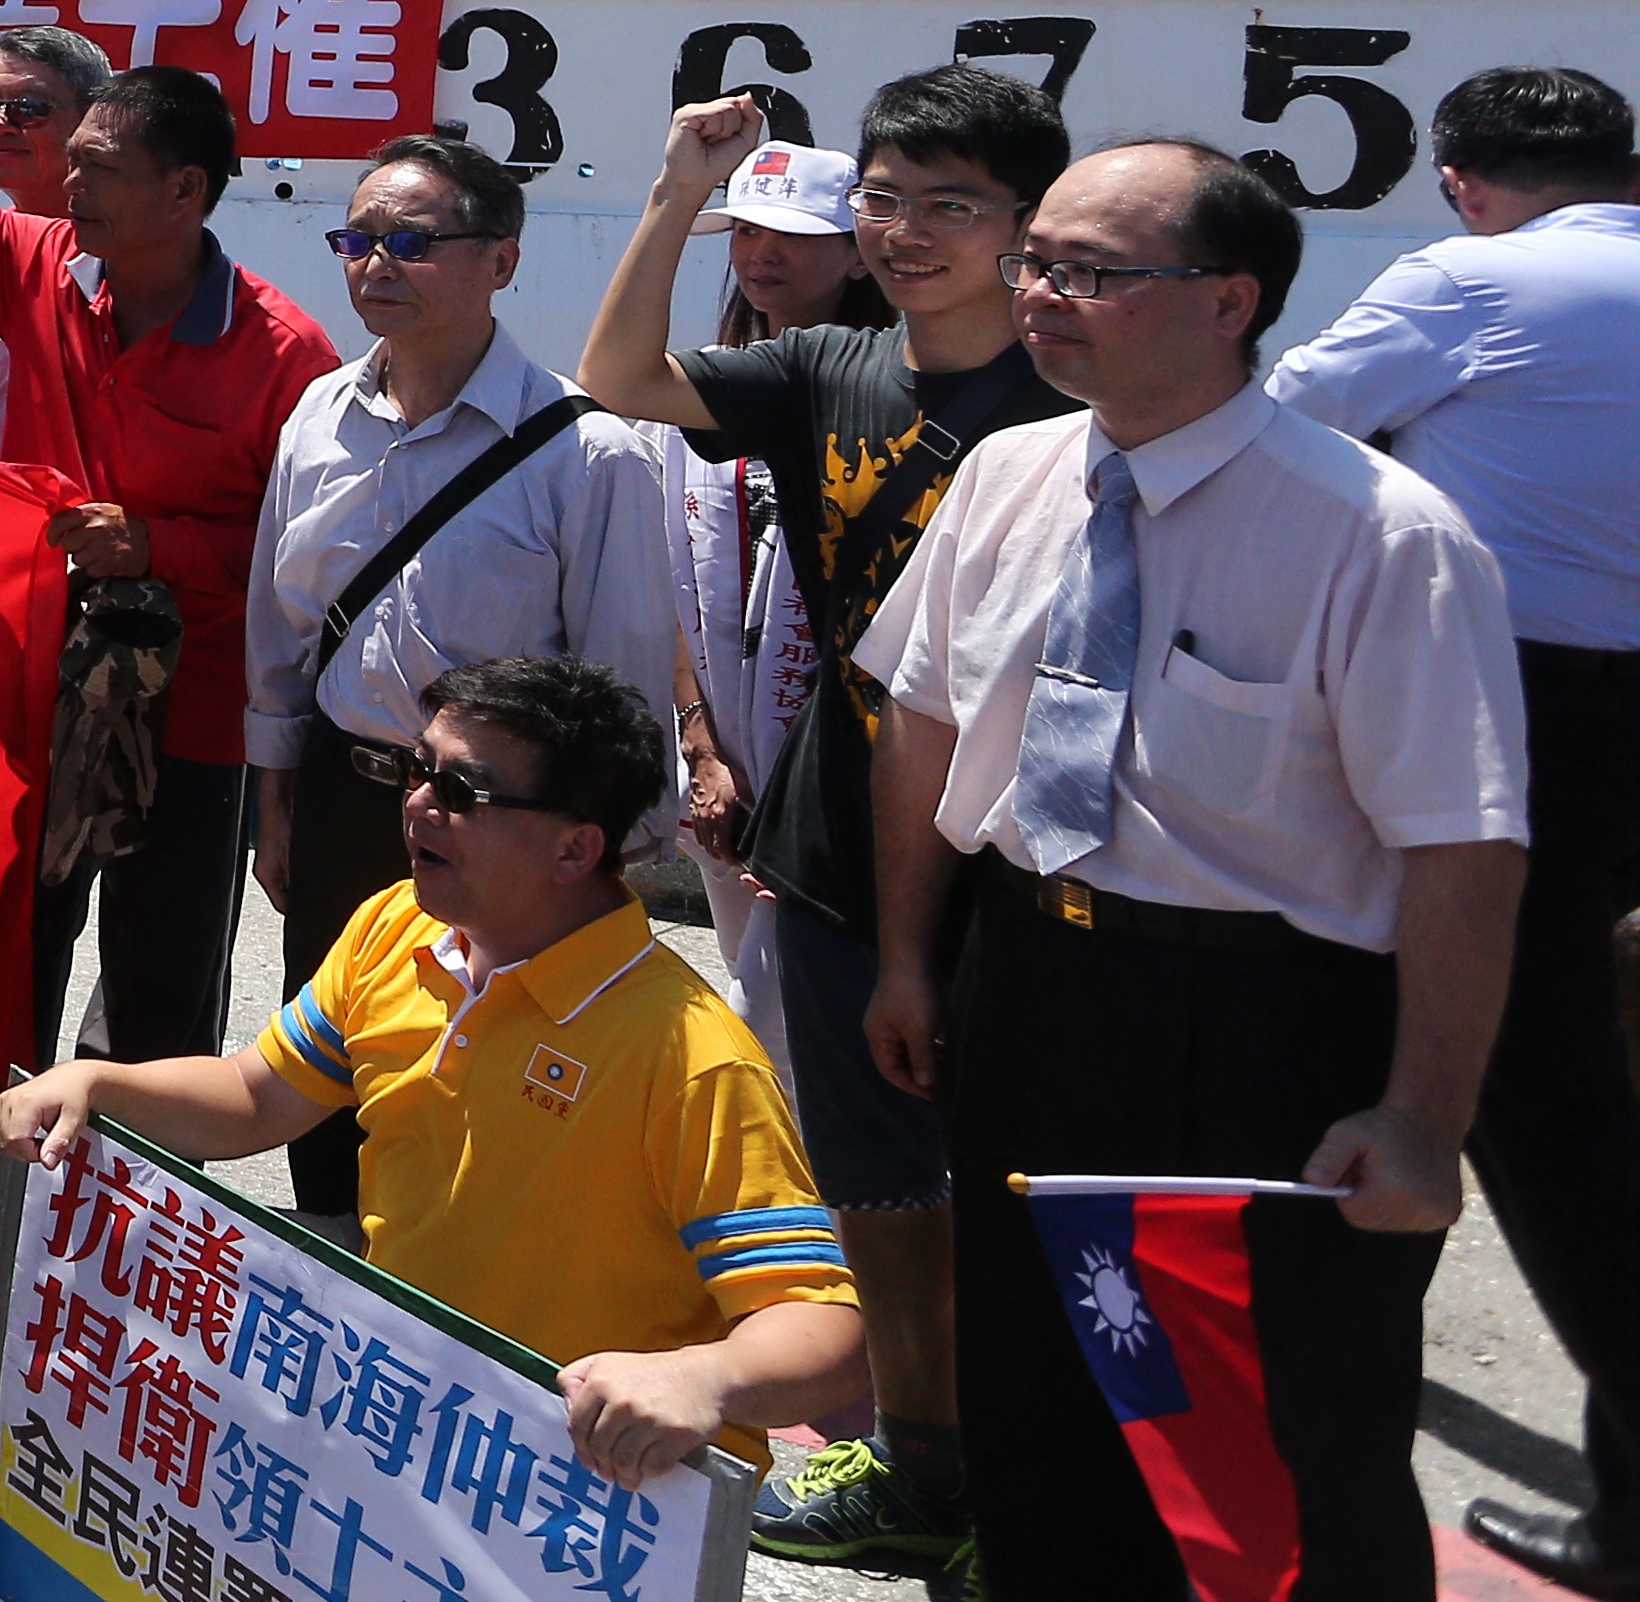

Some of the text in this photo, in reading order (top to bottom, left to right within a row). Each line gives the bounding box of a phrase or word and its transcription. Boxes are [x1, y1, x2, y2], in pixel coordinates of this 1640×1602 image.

[47, 1138, 660, 1600] 抗議南海仲裁
